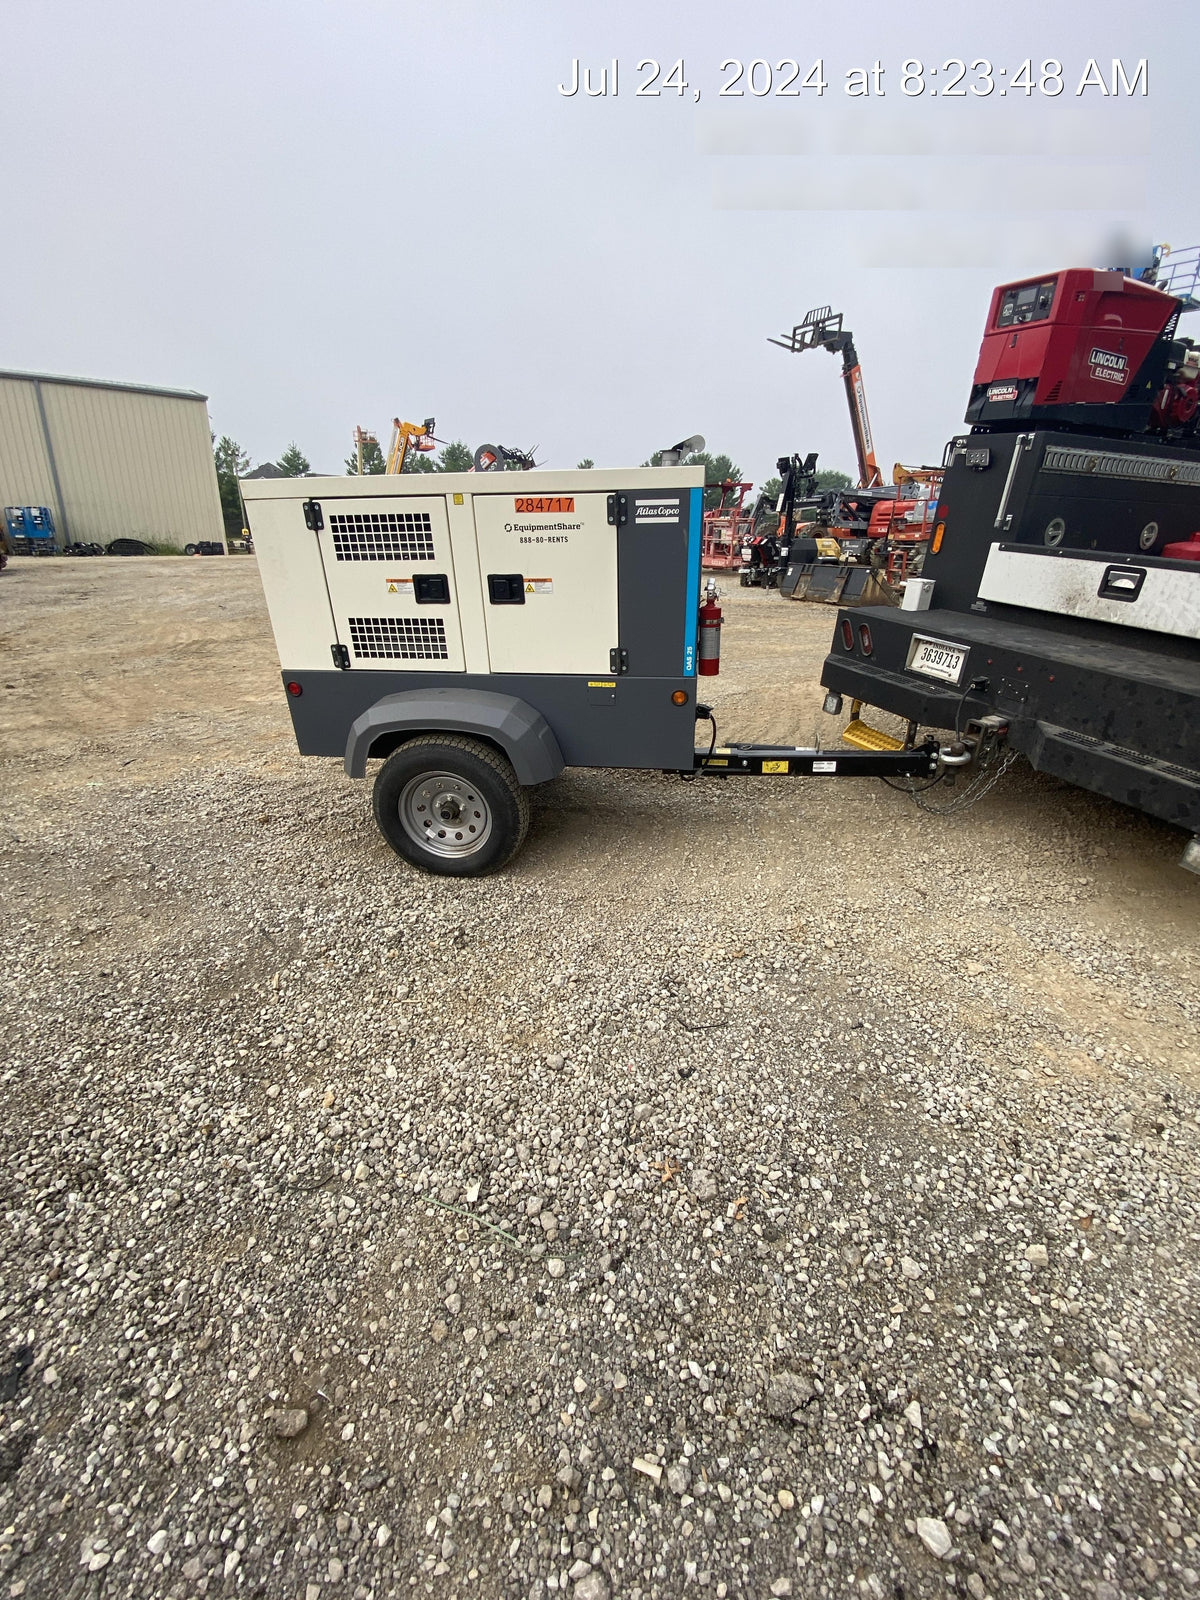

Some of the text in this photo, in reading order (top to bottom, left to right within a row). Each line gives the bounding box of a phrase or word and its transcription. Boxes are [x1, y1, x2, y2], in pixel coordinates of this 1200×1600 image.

[1091, 351, 1126, 370] LINCOLN
[1095, 367, 1125, 382] ELECTRIC
[988, 387, 1014, 396] LINCOLN
[515, 498, 574, 513] 284717
[635, 507, 680, 516] Atlas Copco
[519, 536, 569, 544] 888-80-RENTS
[932, 643, 956, 653] INDIANA
[920, 647, 961, 670] 3639713
